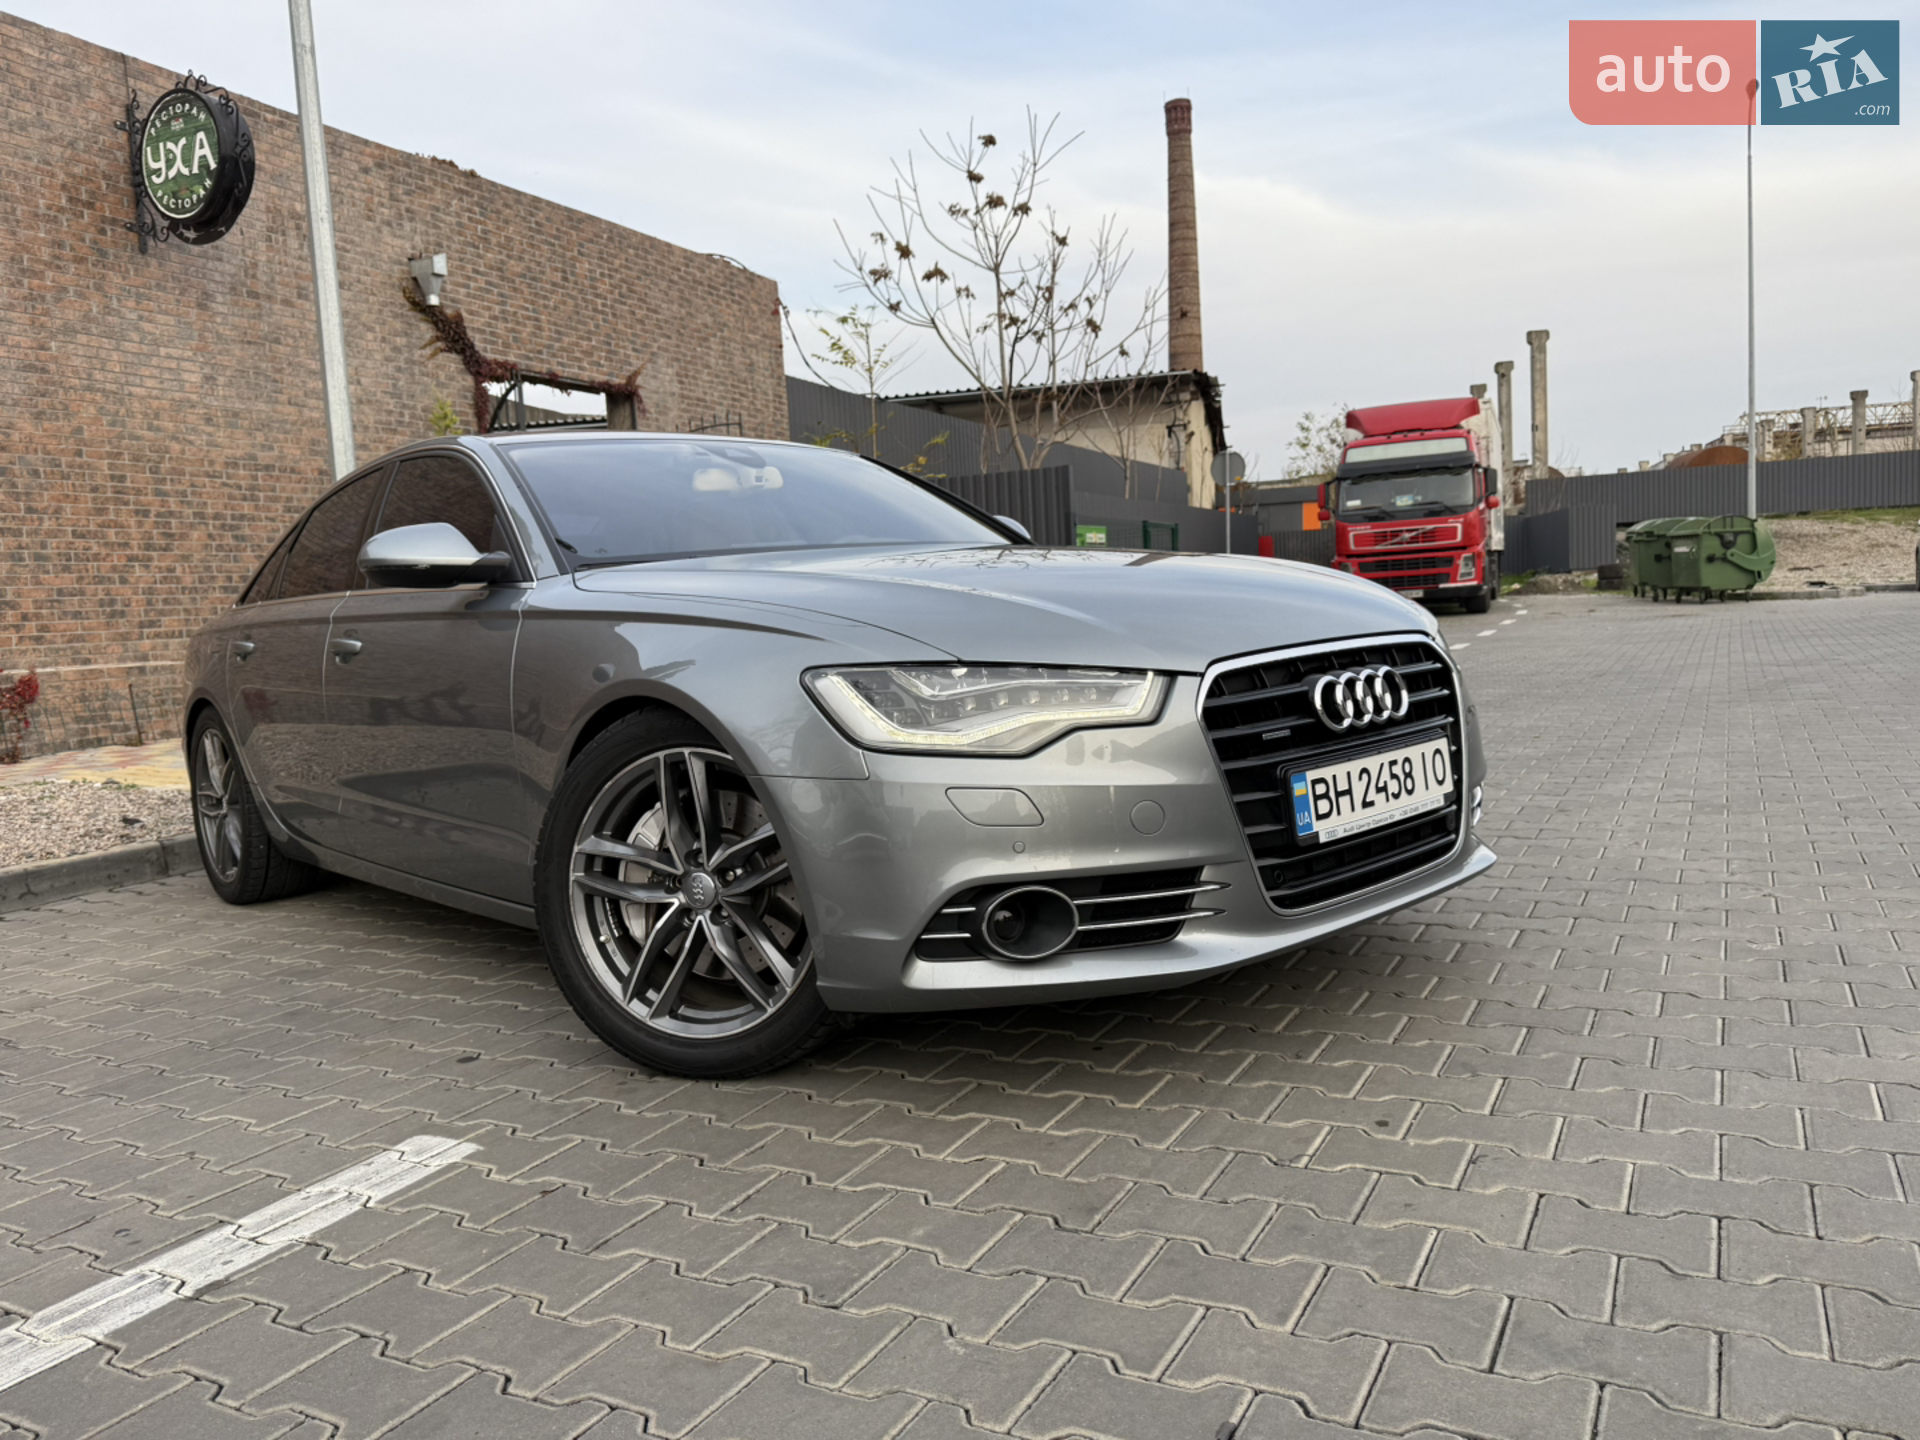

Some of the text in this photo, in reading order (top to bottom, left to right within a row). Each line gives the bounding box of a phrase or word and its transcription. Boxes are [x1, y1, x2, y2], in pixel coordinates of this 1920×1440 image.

[150, 103, 206, 137] РЕСТОРАН
[146, 131, 217, 184] УХА
[156, 178, 212, 209] РЕСТОРАН
[1310, 771, 1355, 821] BH
[1358, 757, 1415, 810] 2458
[1296, 811, 1311, 826] UA
